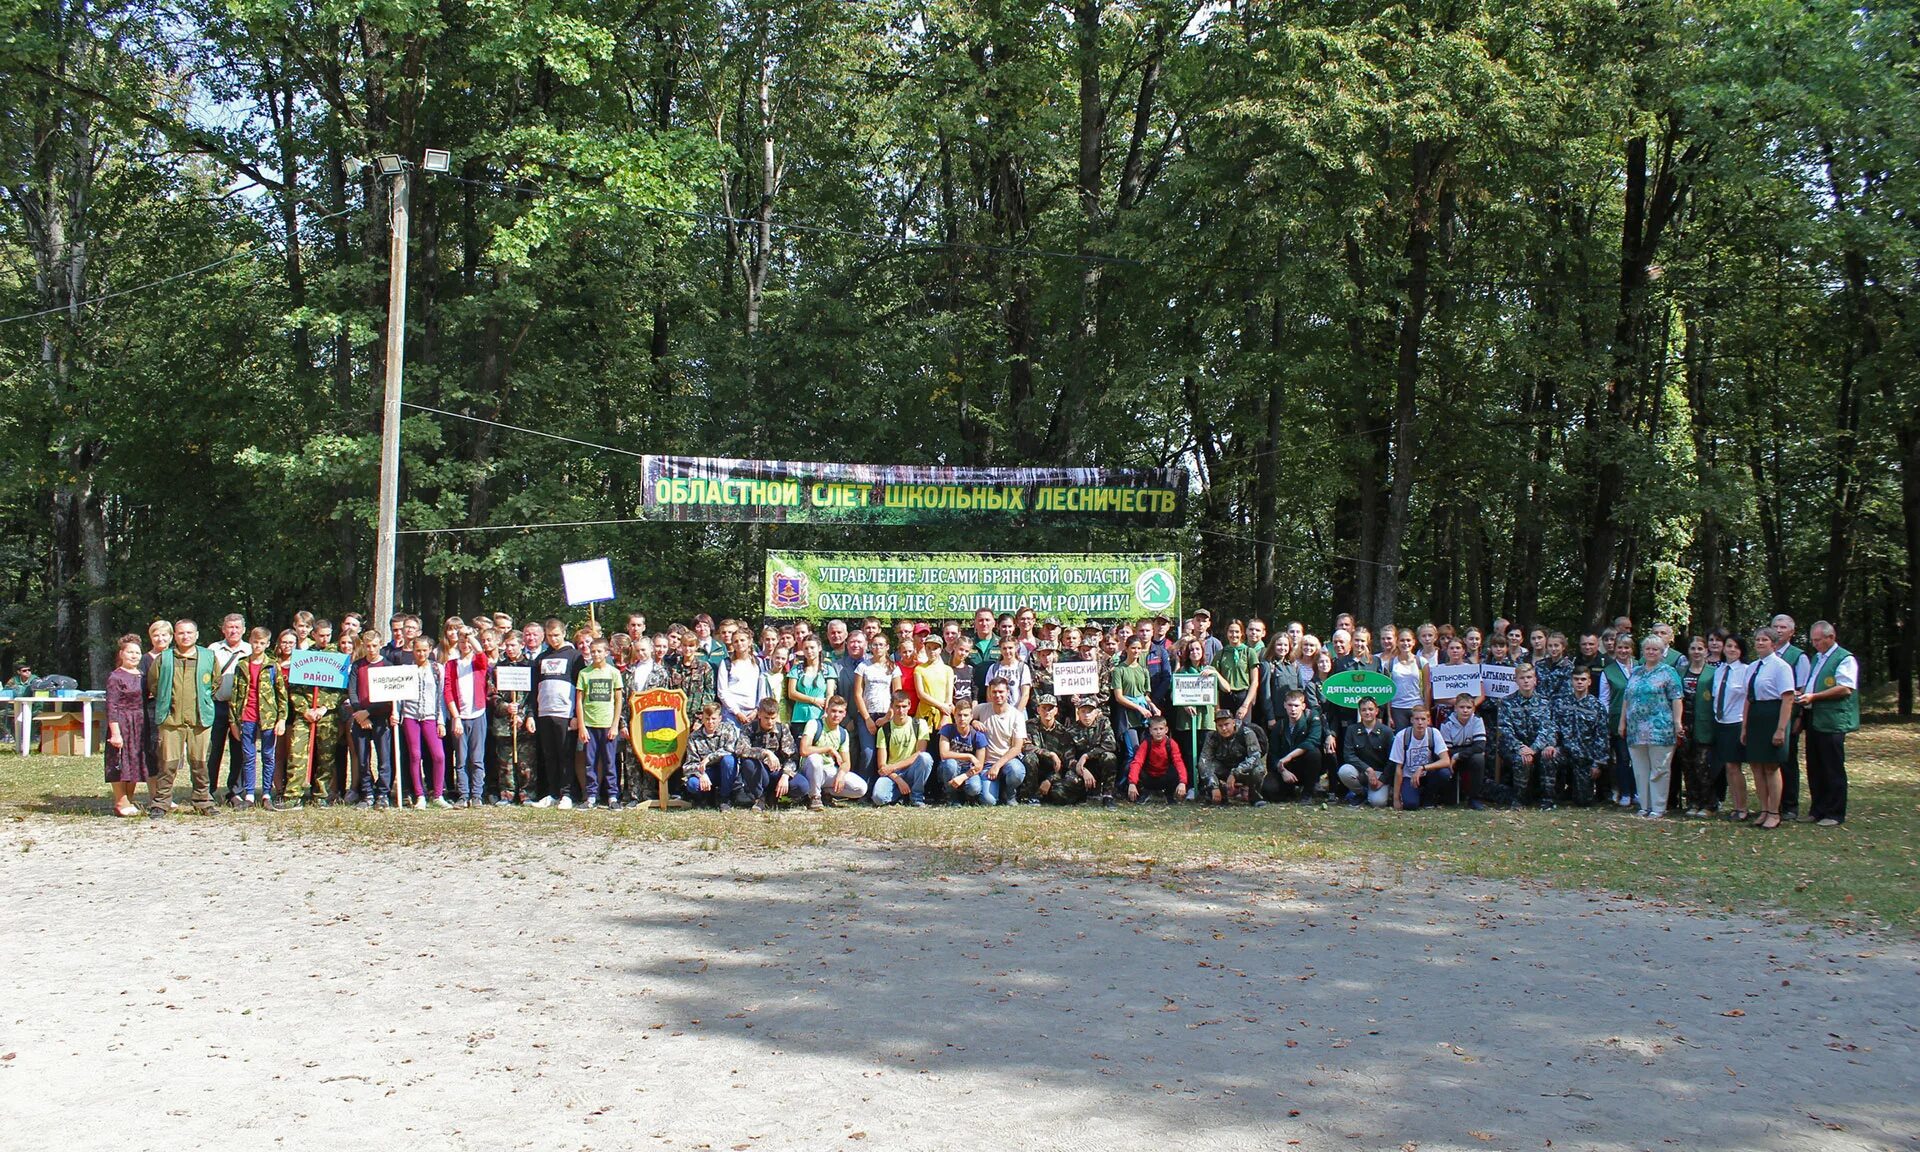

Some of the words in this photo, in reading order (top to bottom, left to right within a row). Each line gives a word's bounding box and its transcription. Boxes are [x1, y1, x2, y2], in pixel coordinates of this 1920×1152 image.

[655, 478, 800, 506] ОБЛАСТНОЙ
[811, 482, 872, 507] СЛЕТ
[884, 485, 1025, 510] ШКОЛЬНЫХ
[1035, 487, 1176, 513] ЛЕСНИЧЕСТВ
[818, 567, 916, 584] УПРАВЛЕНИЕ
[918, 568, 979, 584] ЛЕСАМИ
[982, 566, 1060, 585] БРЯНСКОЙ
[1063, 568, 1130, 585] ОБЛАСТИ
[818, 593, 898, 612] ОХРАНЯЯ
[902, 594, 935, 612] ЛЕС
[1057, 594, 1130, 614] РОДИНУ!
[303, 671, 334, 682] РАЙОН
[1061, 677, 1092, 687] РАЙОН
[1326, 685, 1393, 695] ДЯТЬКОВСКИЙ
[1446, 681, 1469, 690] РАЙОН
[1491, 682, 1510, 694] РАЙОН
